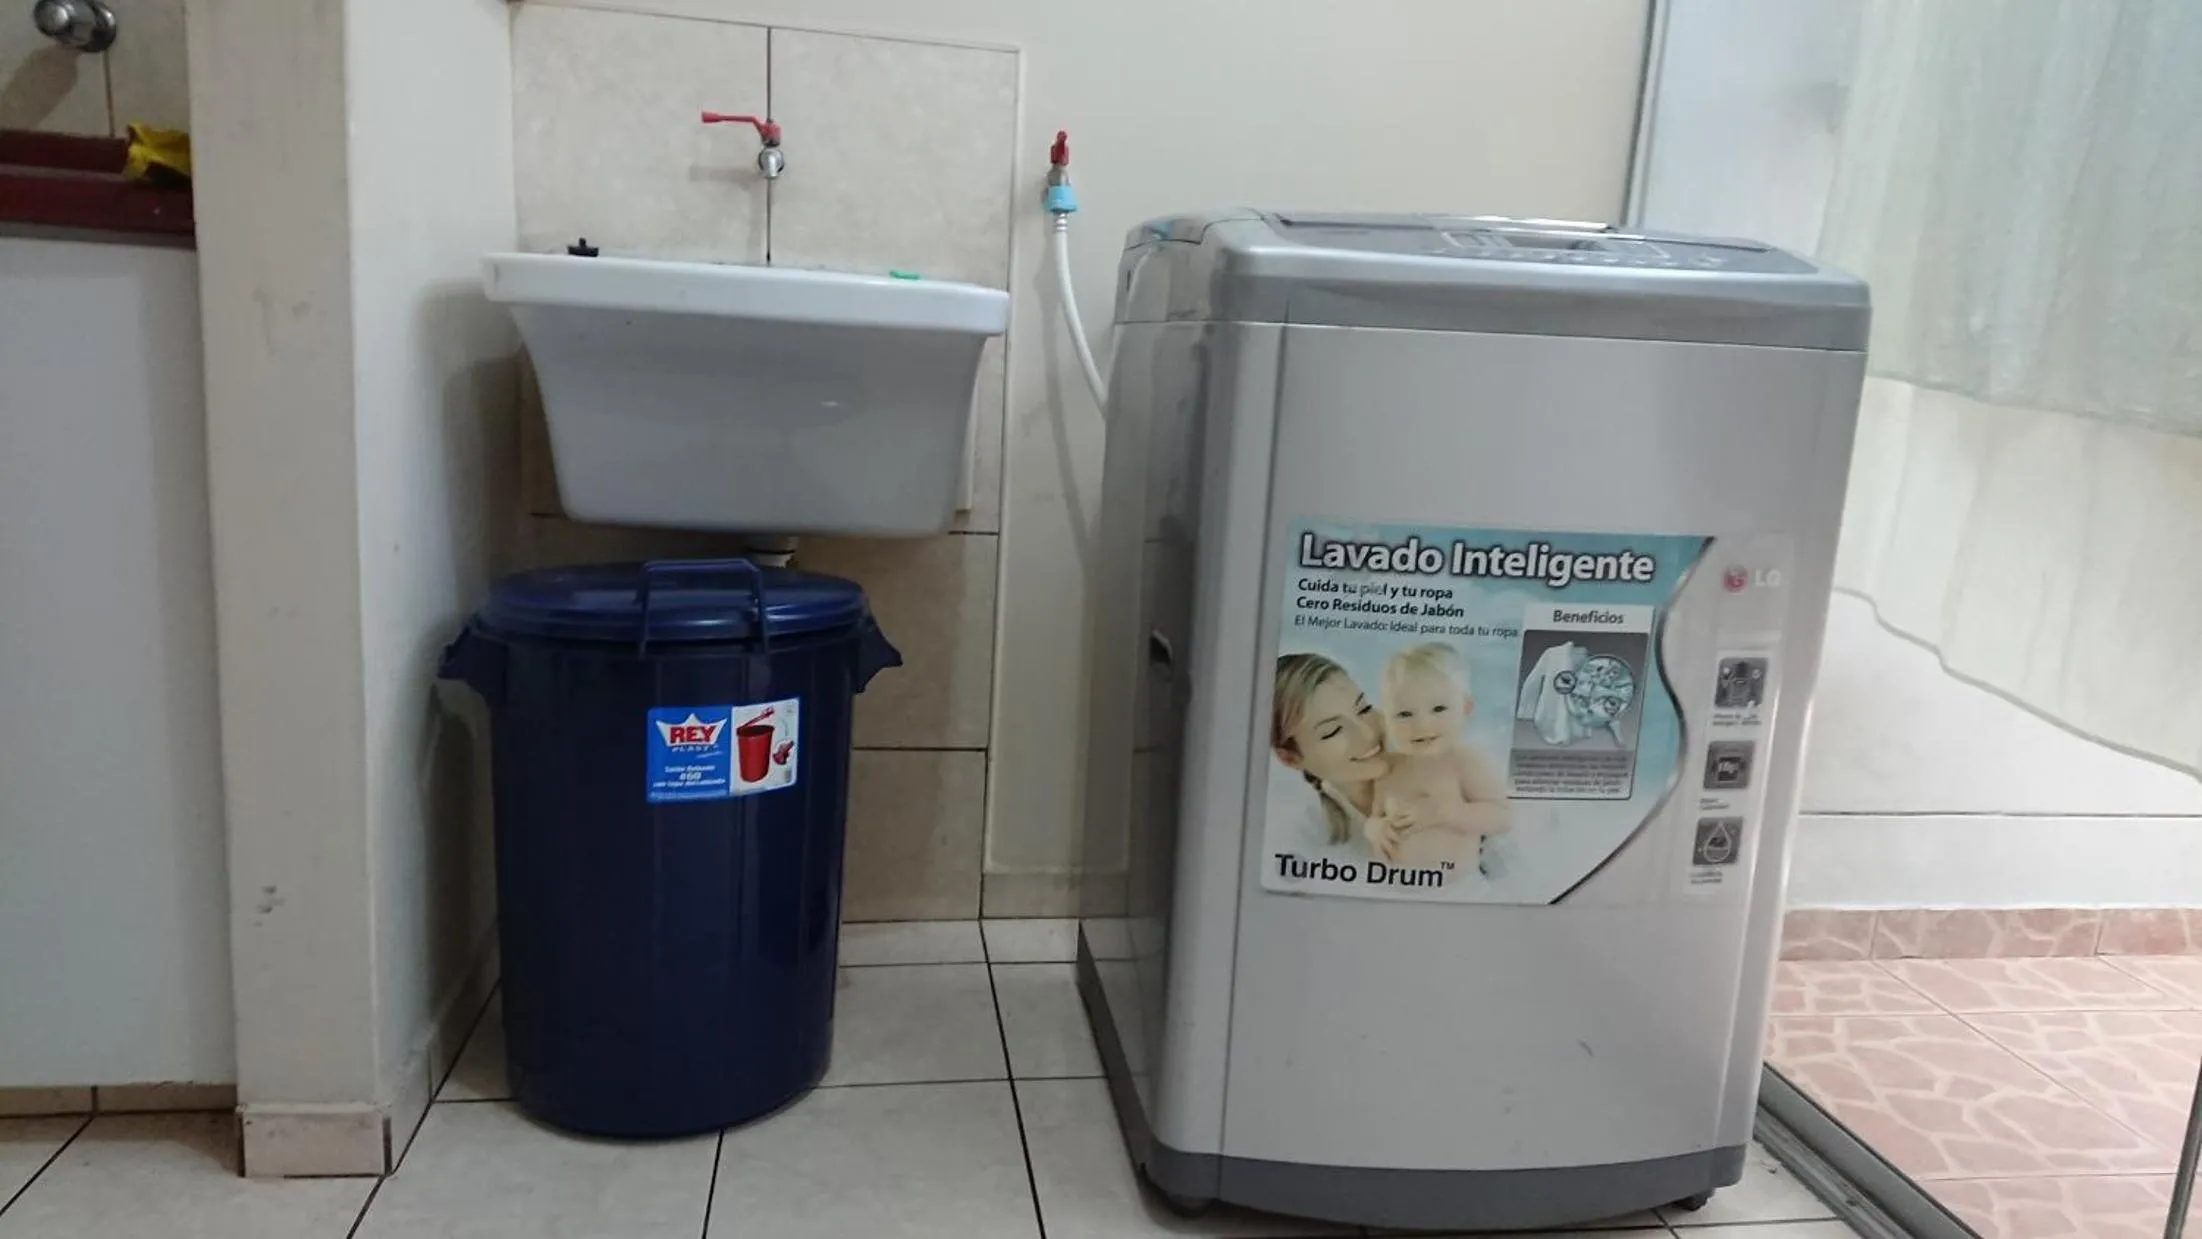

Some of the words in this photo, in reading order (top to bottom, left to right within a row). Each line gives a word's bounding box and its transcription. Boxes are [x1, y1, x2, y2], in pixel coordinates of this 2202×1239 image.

[1301, 532, 1443, 574] Lavado
[1451, 540, 1656, 588] Inteligente
[1754, 568, 1782, 587] LG
[1298, 578, 1339, 594] Cuida
[1343, 581, 1357, 594] tu
[1390, 587, 1398, 599] y
[1402, 585, 1415, 597] tu
[1420, 588, 1453, 600] ropa
[1296, 596, 1329, 610] Cero
[1332, 598, 1397, 615] Residuos
[1400, 602, 1418, 615] de
[1421, 603, 1464, 618] Jabón
[1553, 608, 1624, 625] Beneficios
[1294, 614, 1305, 626] El
[1307, 615, 1342, 631] Mejor
[1420, 622, 1445, 635] para
[1449, 622, 1474, 636] toda
[1478, 624, 1489, 637] tu
[1492, 625, 1518, 638] ropa
[669, 725, 719, 744] REY
[1275, 853, 1357, 882] Turbo
